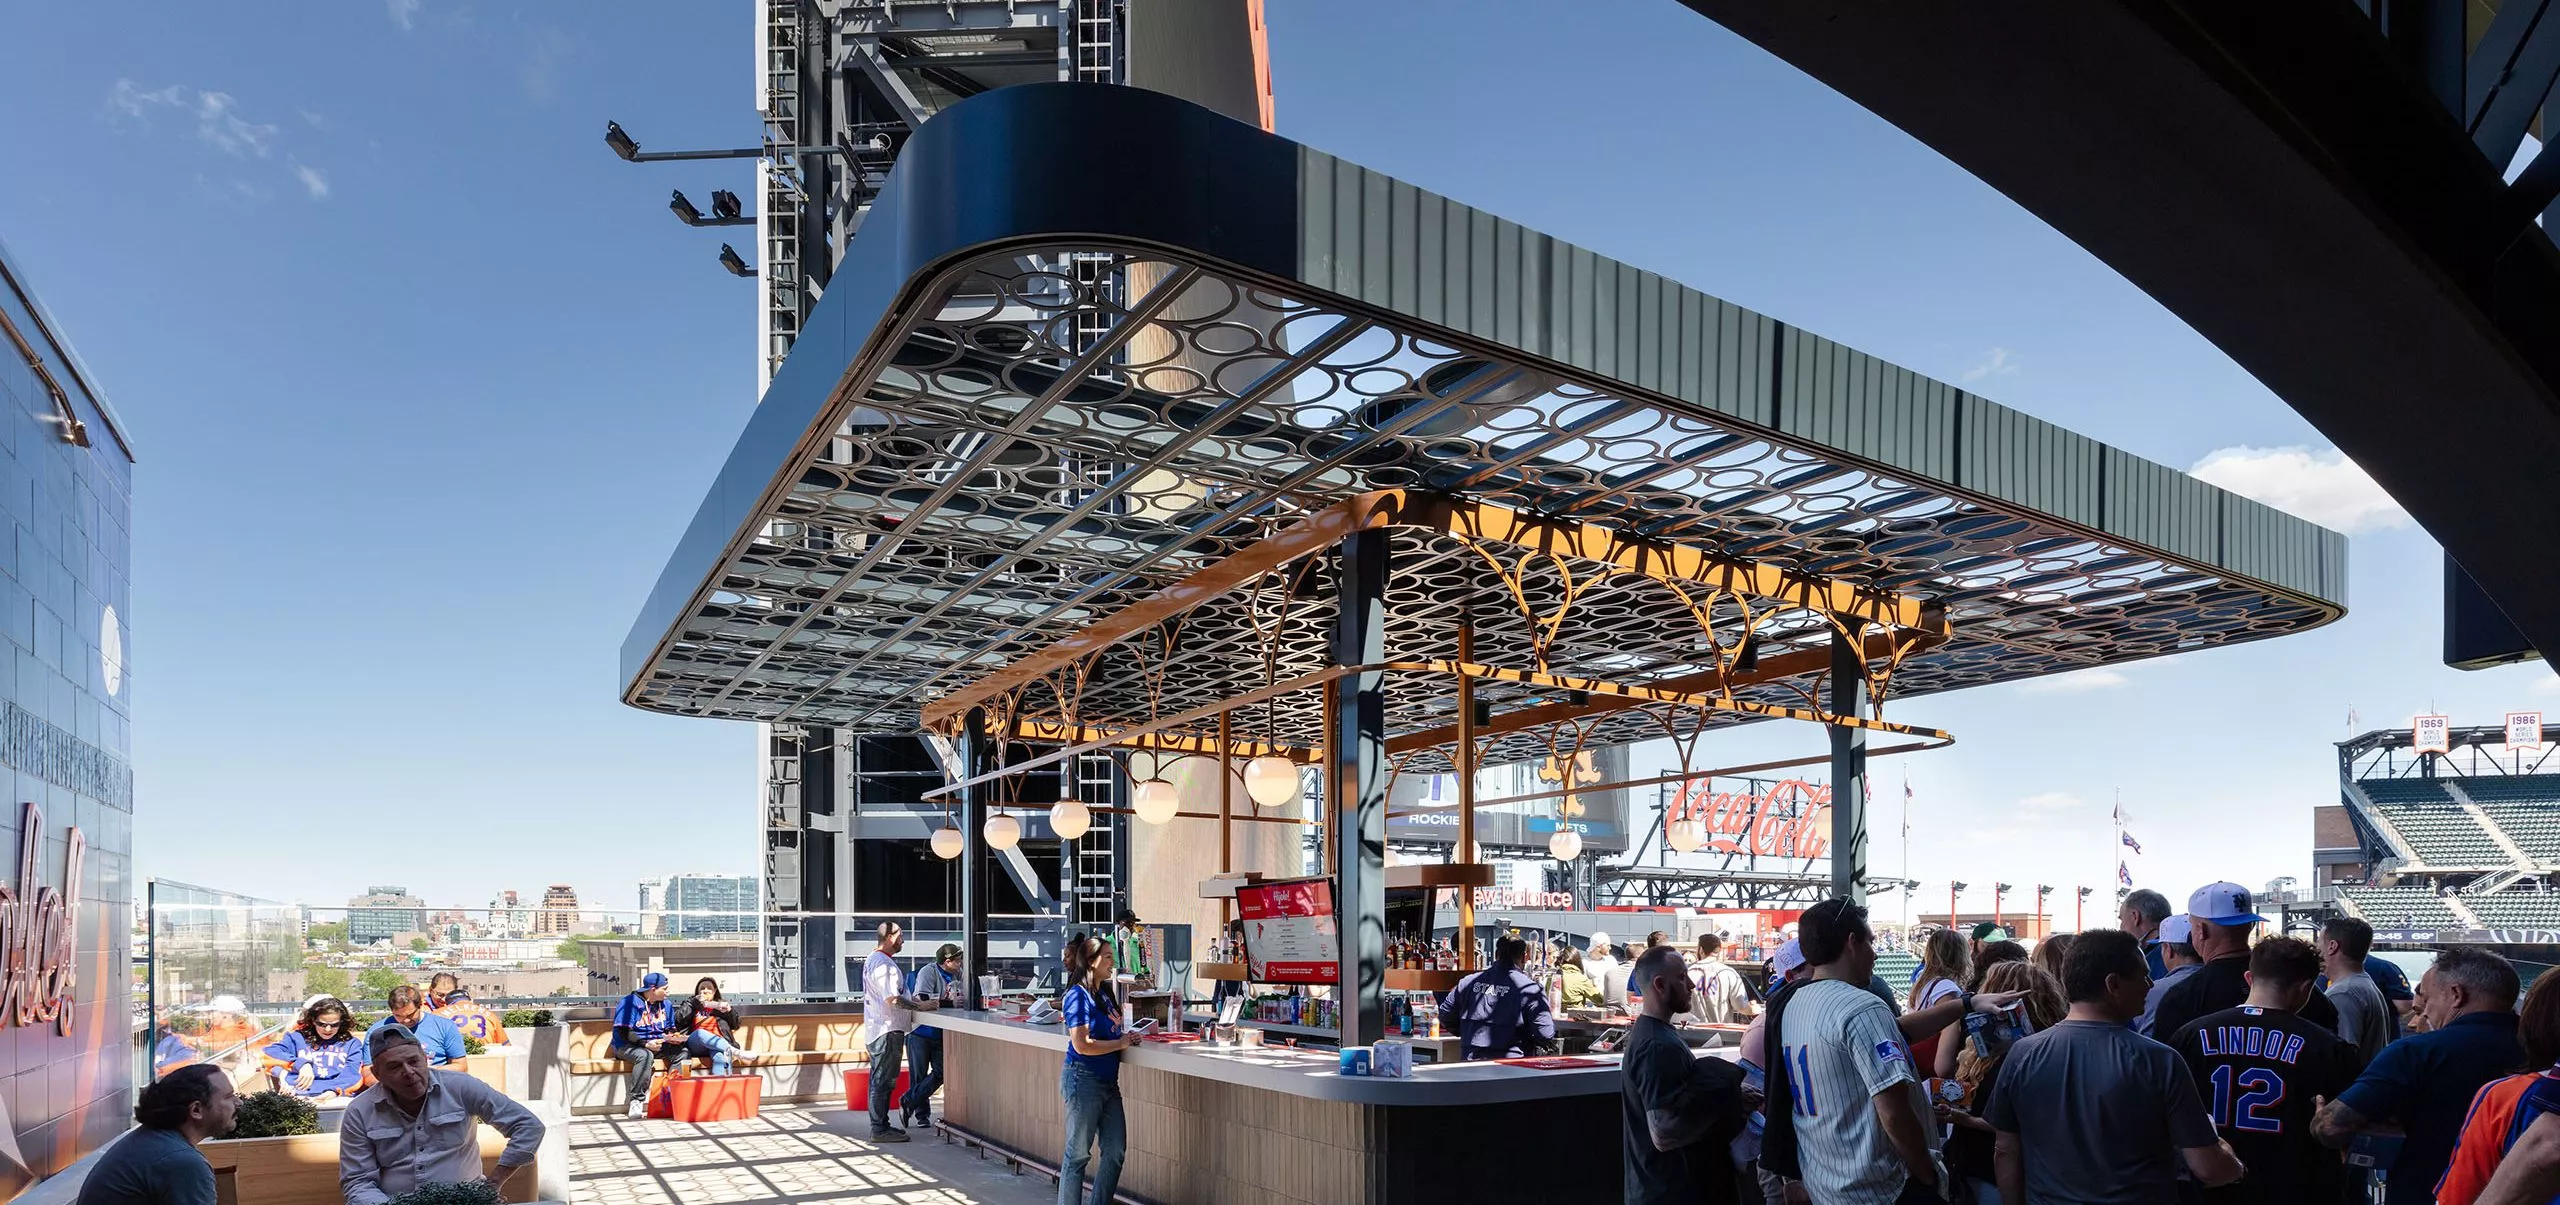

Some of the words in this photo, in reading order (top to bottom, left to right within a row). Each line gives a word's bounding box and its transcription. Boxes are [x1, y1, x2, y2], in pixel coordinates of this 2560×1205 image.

[2420, 719, 2443, 728] 1969
[2512, 716, 2536, 725] 1986
[1555, 822, 1588, 833] METS
[1502, 886, 1573, 907] balance
[1472, 981, 1511, 997] STAFF
[2200, 1026, 2305, 1065] LINDOR
[297, 1049, 348, 1069] METS
[2210, 1064, 2286, 1133] 12
